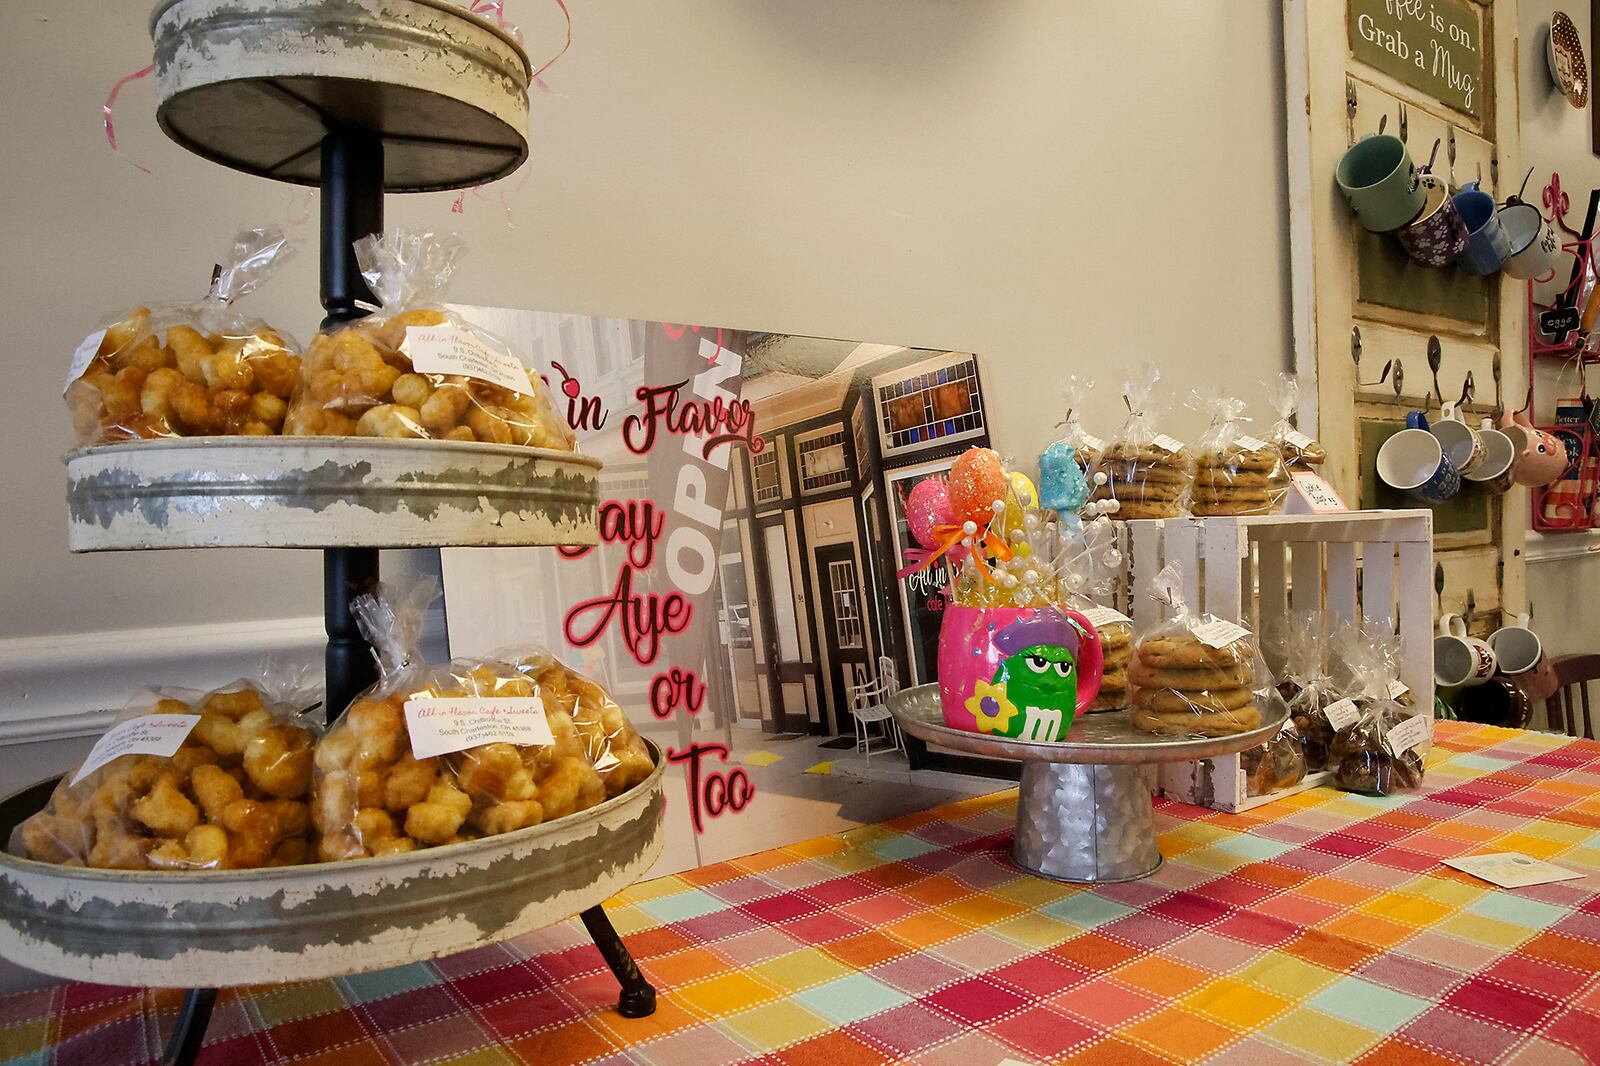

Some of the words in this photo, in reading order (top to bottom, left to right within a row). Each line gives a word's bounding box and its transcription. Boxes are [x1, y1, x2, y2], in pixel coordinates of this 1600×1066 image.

[1358, 14, 1409, 60] Grab
[1415, 51, 1426, 70] a
[1430, 39, 1476, 108] Mug
[1429, 4, 1444, 33] is
[1449, 24, 1476, 52] on.
[622, 378, 765, 461] Flavor
[557, 500, 665, 569] ay
[564, 563, 692, 666] Aye
[417, 706, 436, 719] All
[651, 668, 706, 719] or
[438, 727, 460, 737] South
[667, 742, 755, 834] Too
